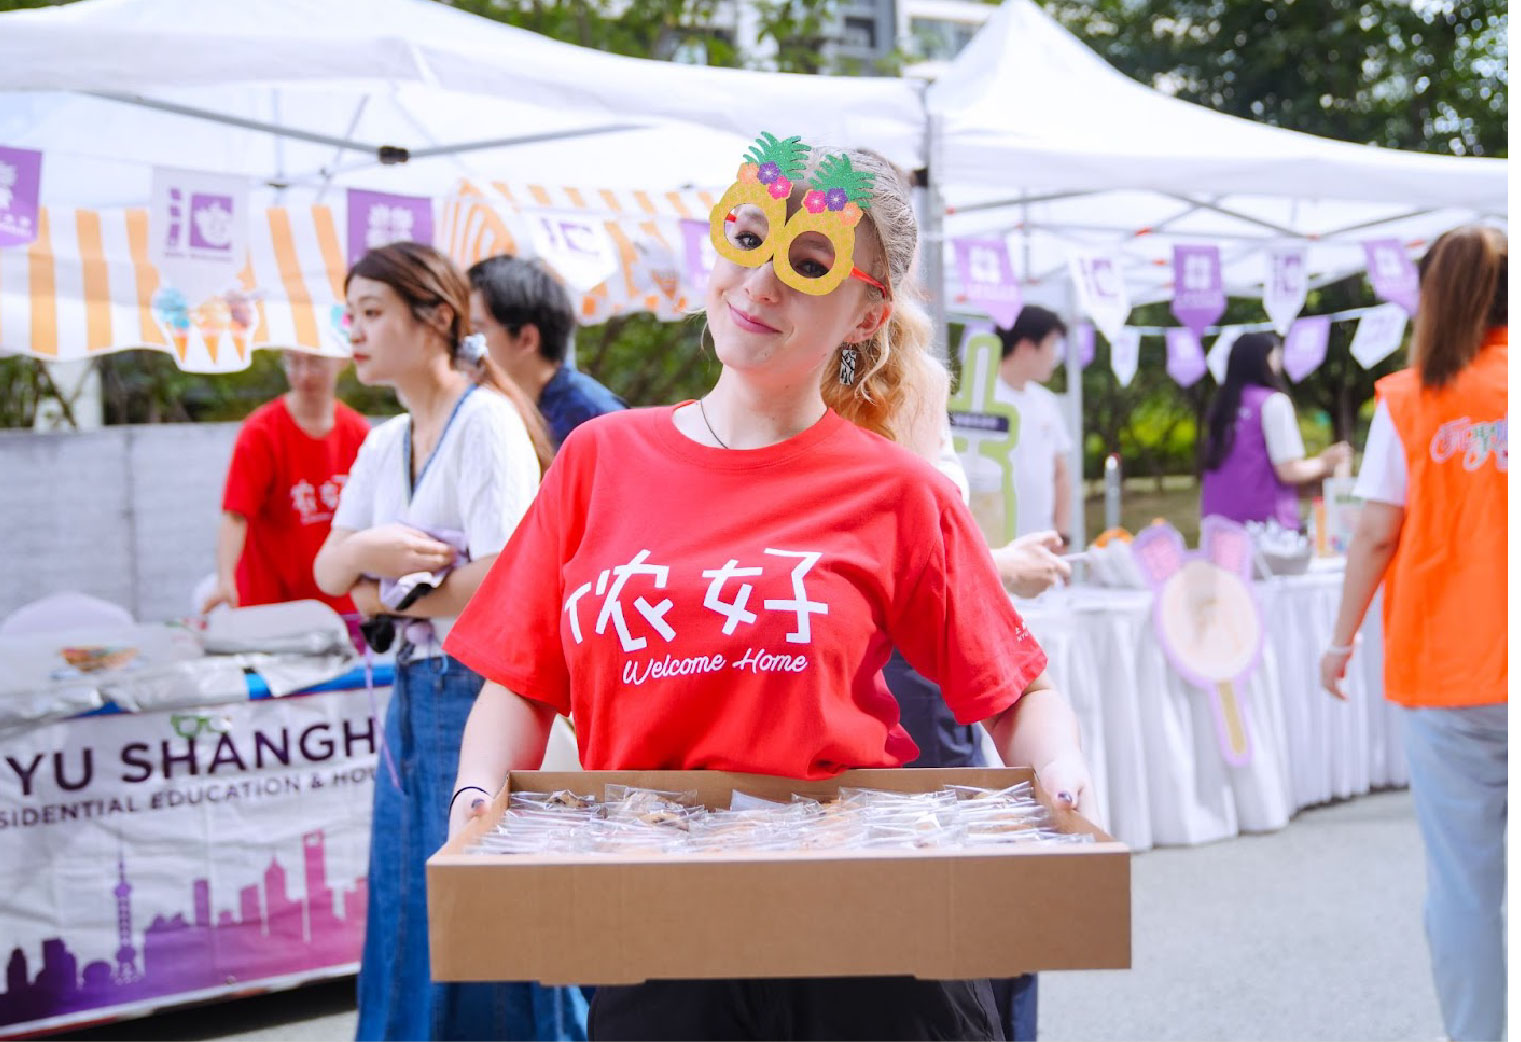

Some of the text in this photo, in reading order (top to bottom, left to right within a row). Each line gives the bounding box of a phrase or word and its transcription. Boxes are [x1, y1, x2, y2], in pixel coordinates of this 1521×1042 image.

[622, 648, 809, 685] Welcome Home
[6, 748, 94, 797] YU
[151, 775, 300, 809] EDUCATION
[311, 772, 325, 788] &
